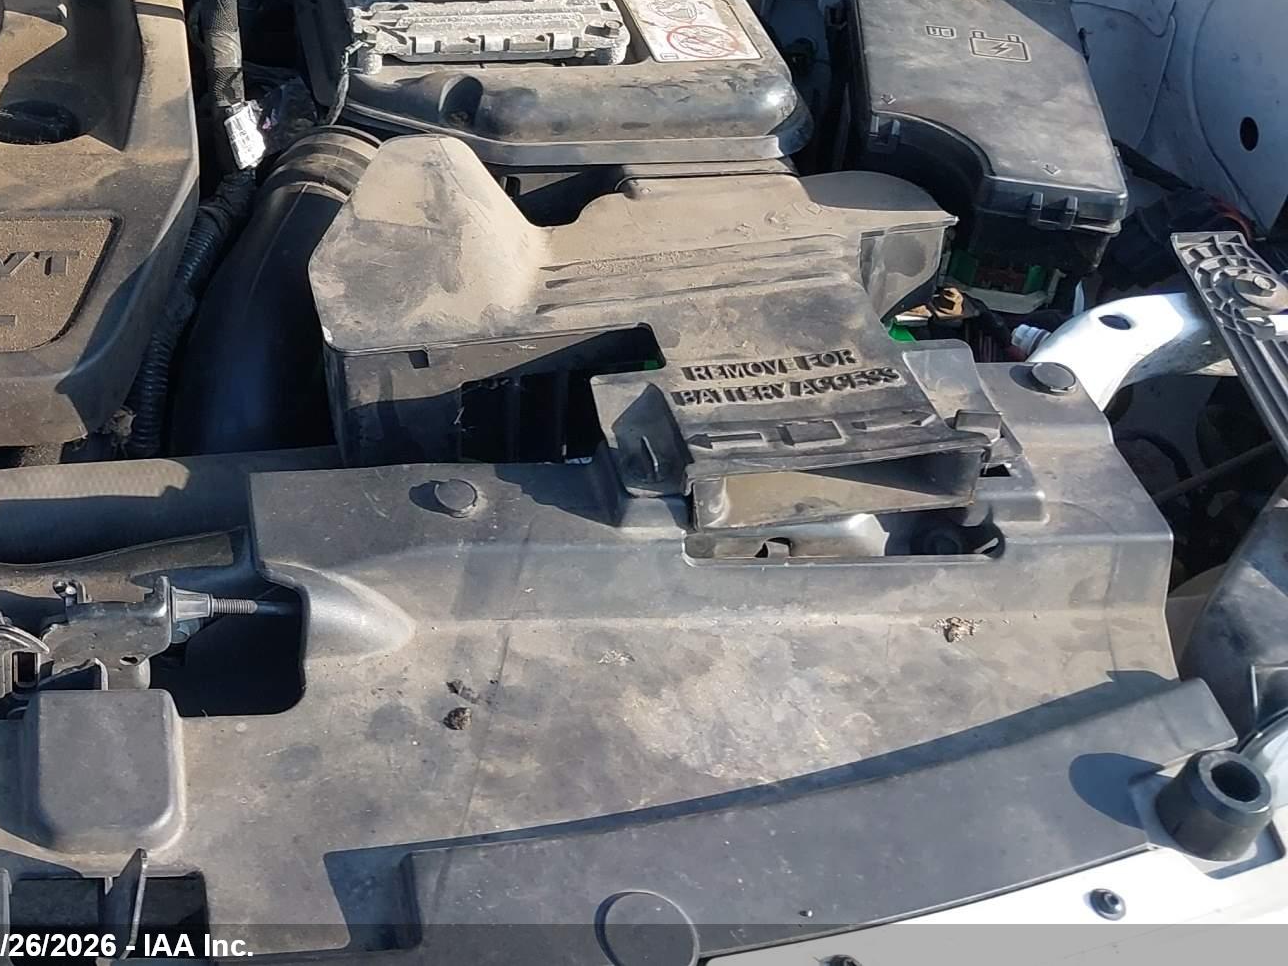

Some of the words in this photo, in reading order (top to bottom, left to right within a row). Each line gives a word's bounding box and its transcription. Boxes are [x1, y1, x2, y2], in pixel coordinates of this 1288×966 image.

[685, 359, 796, 381] REMOVE
[801, 348, 857, 370] FOR
[673, 383, 787, 406] BATTERY
[793, 367, 905, 397] ACCESS
